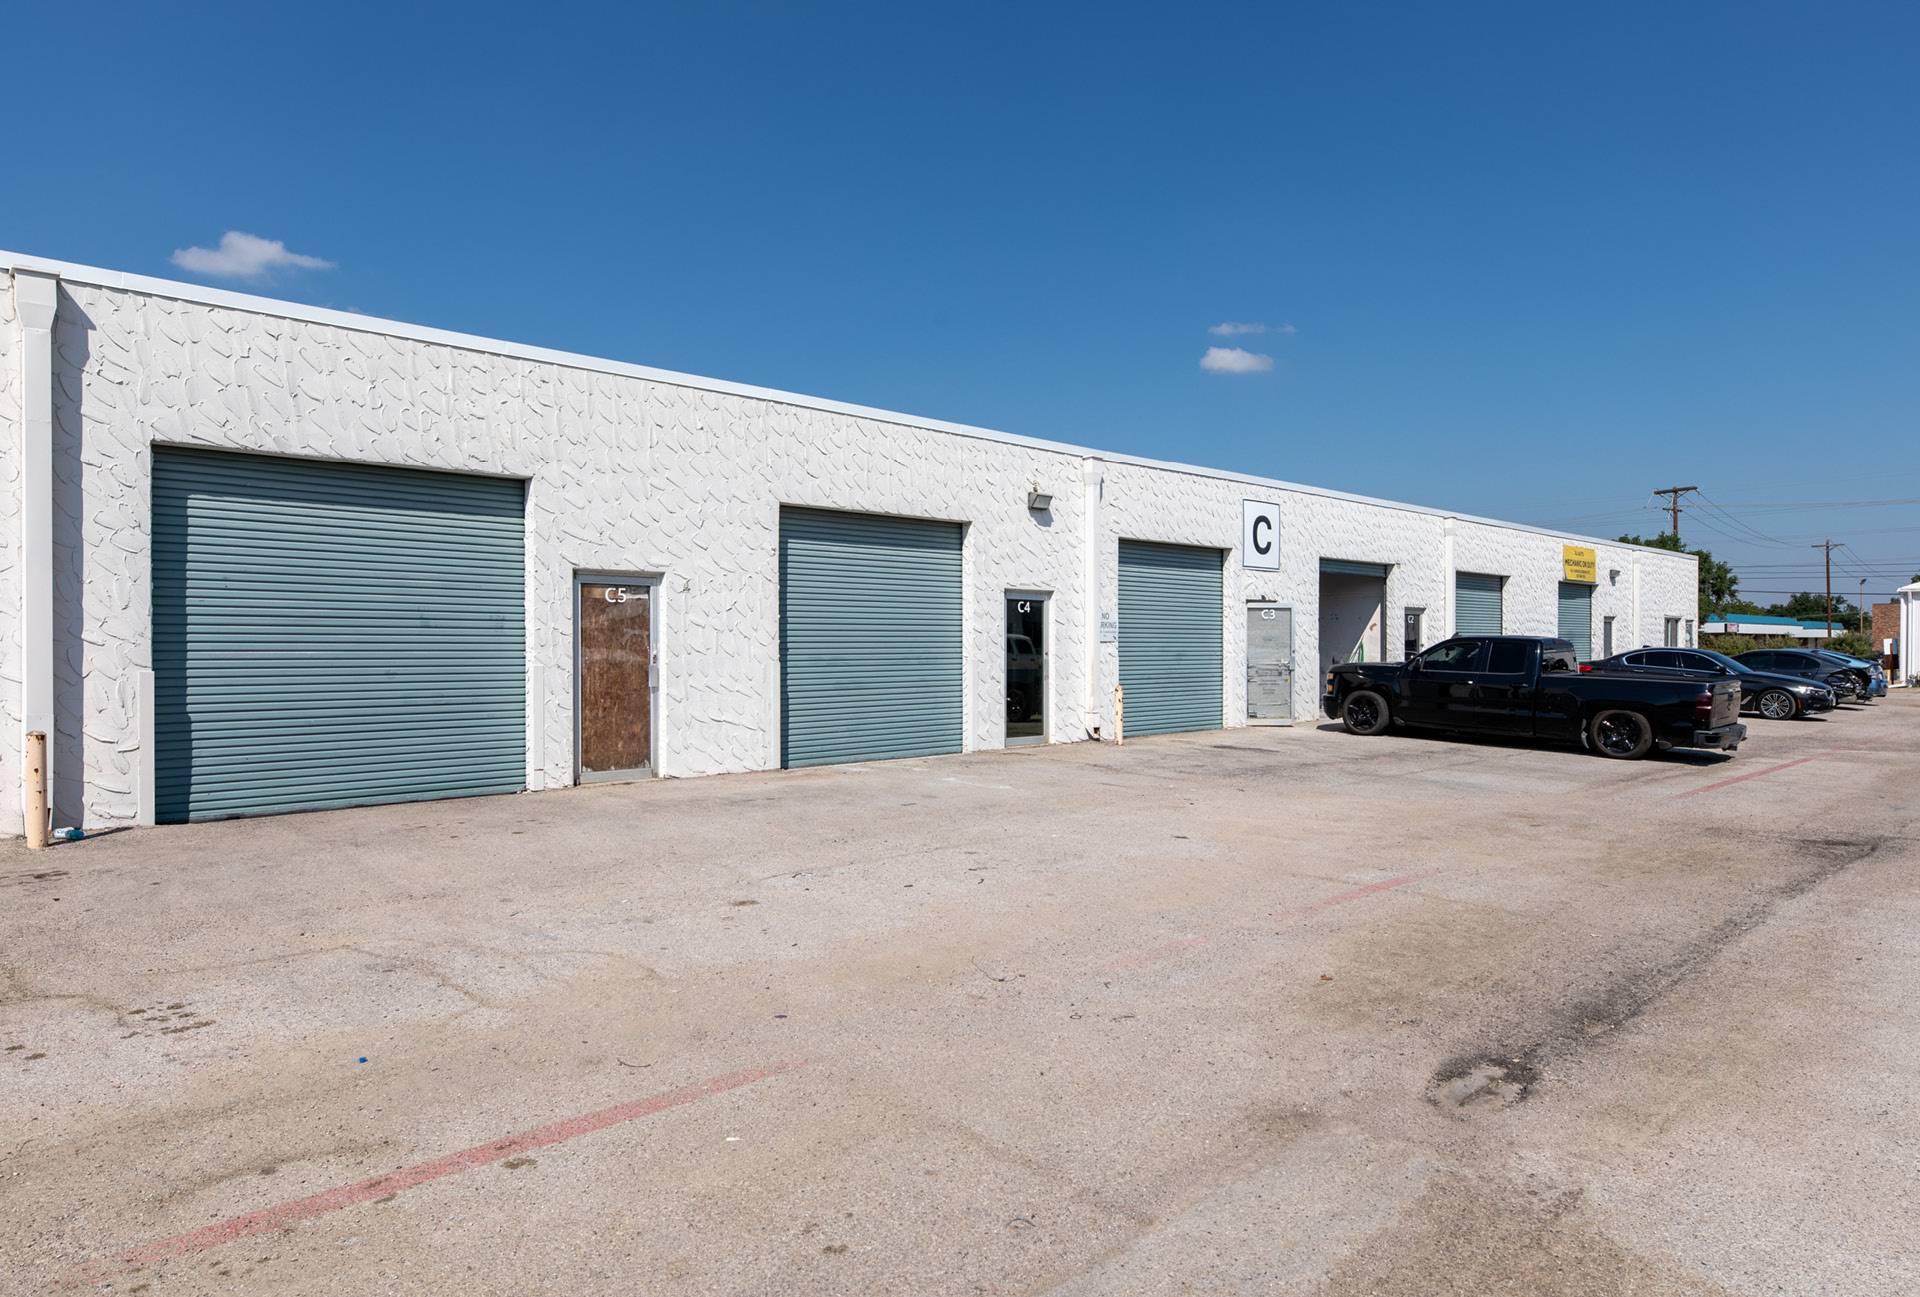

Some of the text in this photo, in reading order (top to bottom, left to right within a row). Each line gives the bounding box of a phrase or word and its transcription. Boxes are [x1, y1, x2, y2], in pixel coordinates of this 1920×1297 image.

[1252, 515, 1272, 555] C
[1565, 559, 1582, 567] MECHANIC
[604, 587, 627, 603] C5
[1017, 601, 1031, 613] C4
[1101, 612, 1110, 620] NO
[1261, 609, 1276, 619] C3
[1407, 615, 1415, 624] C2
[1100, 621, 1117, 629] RKING
